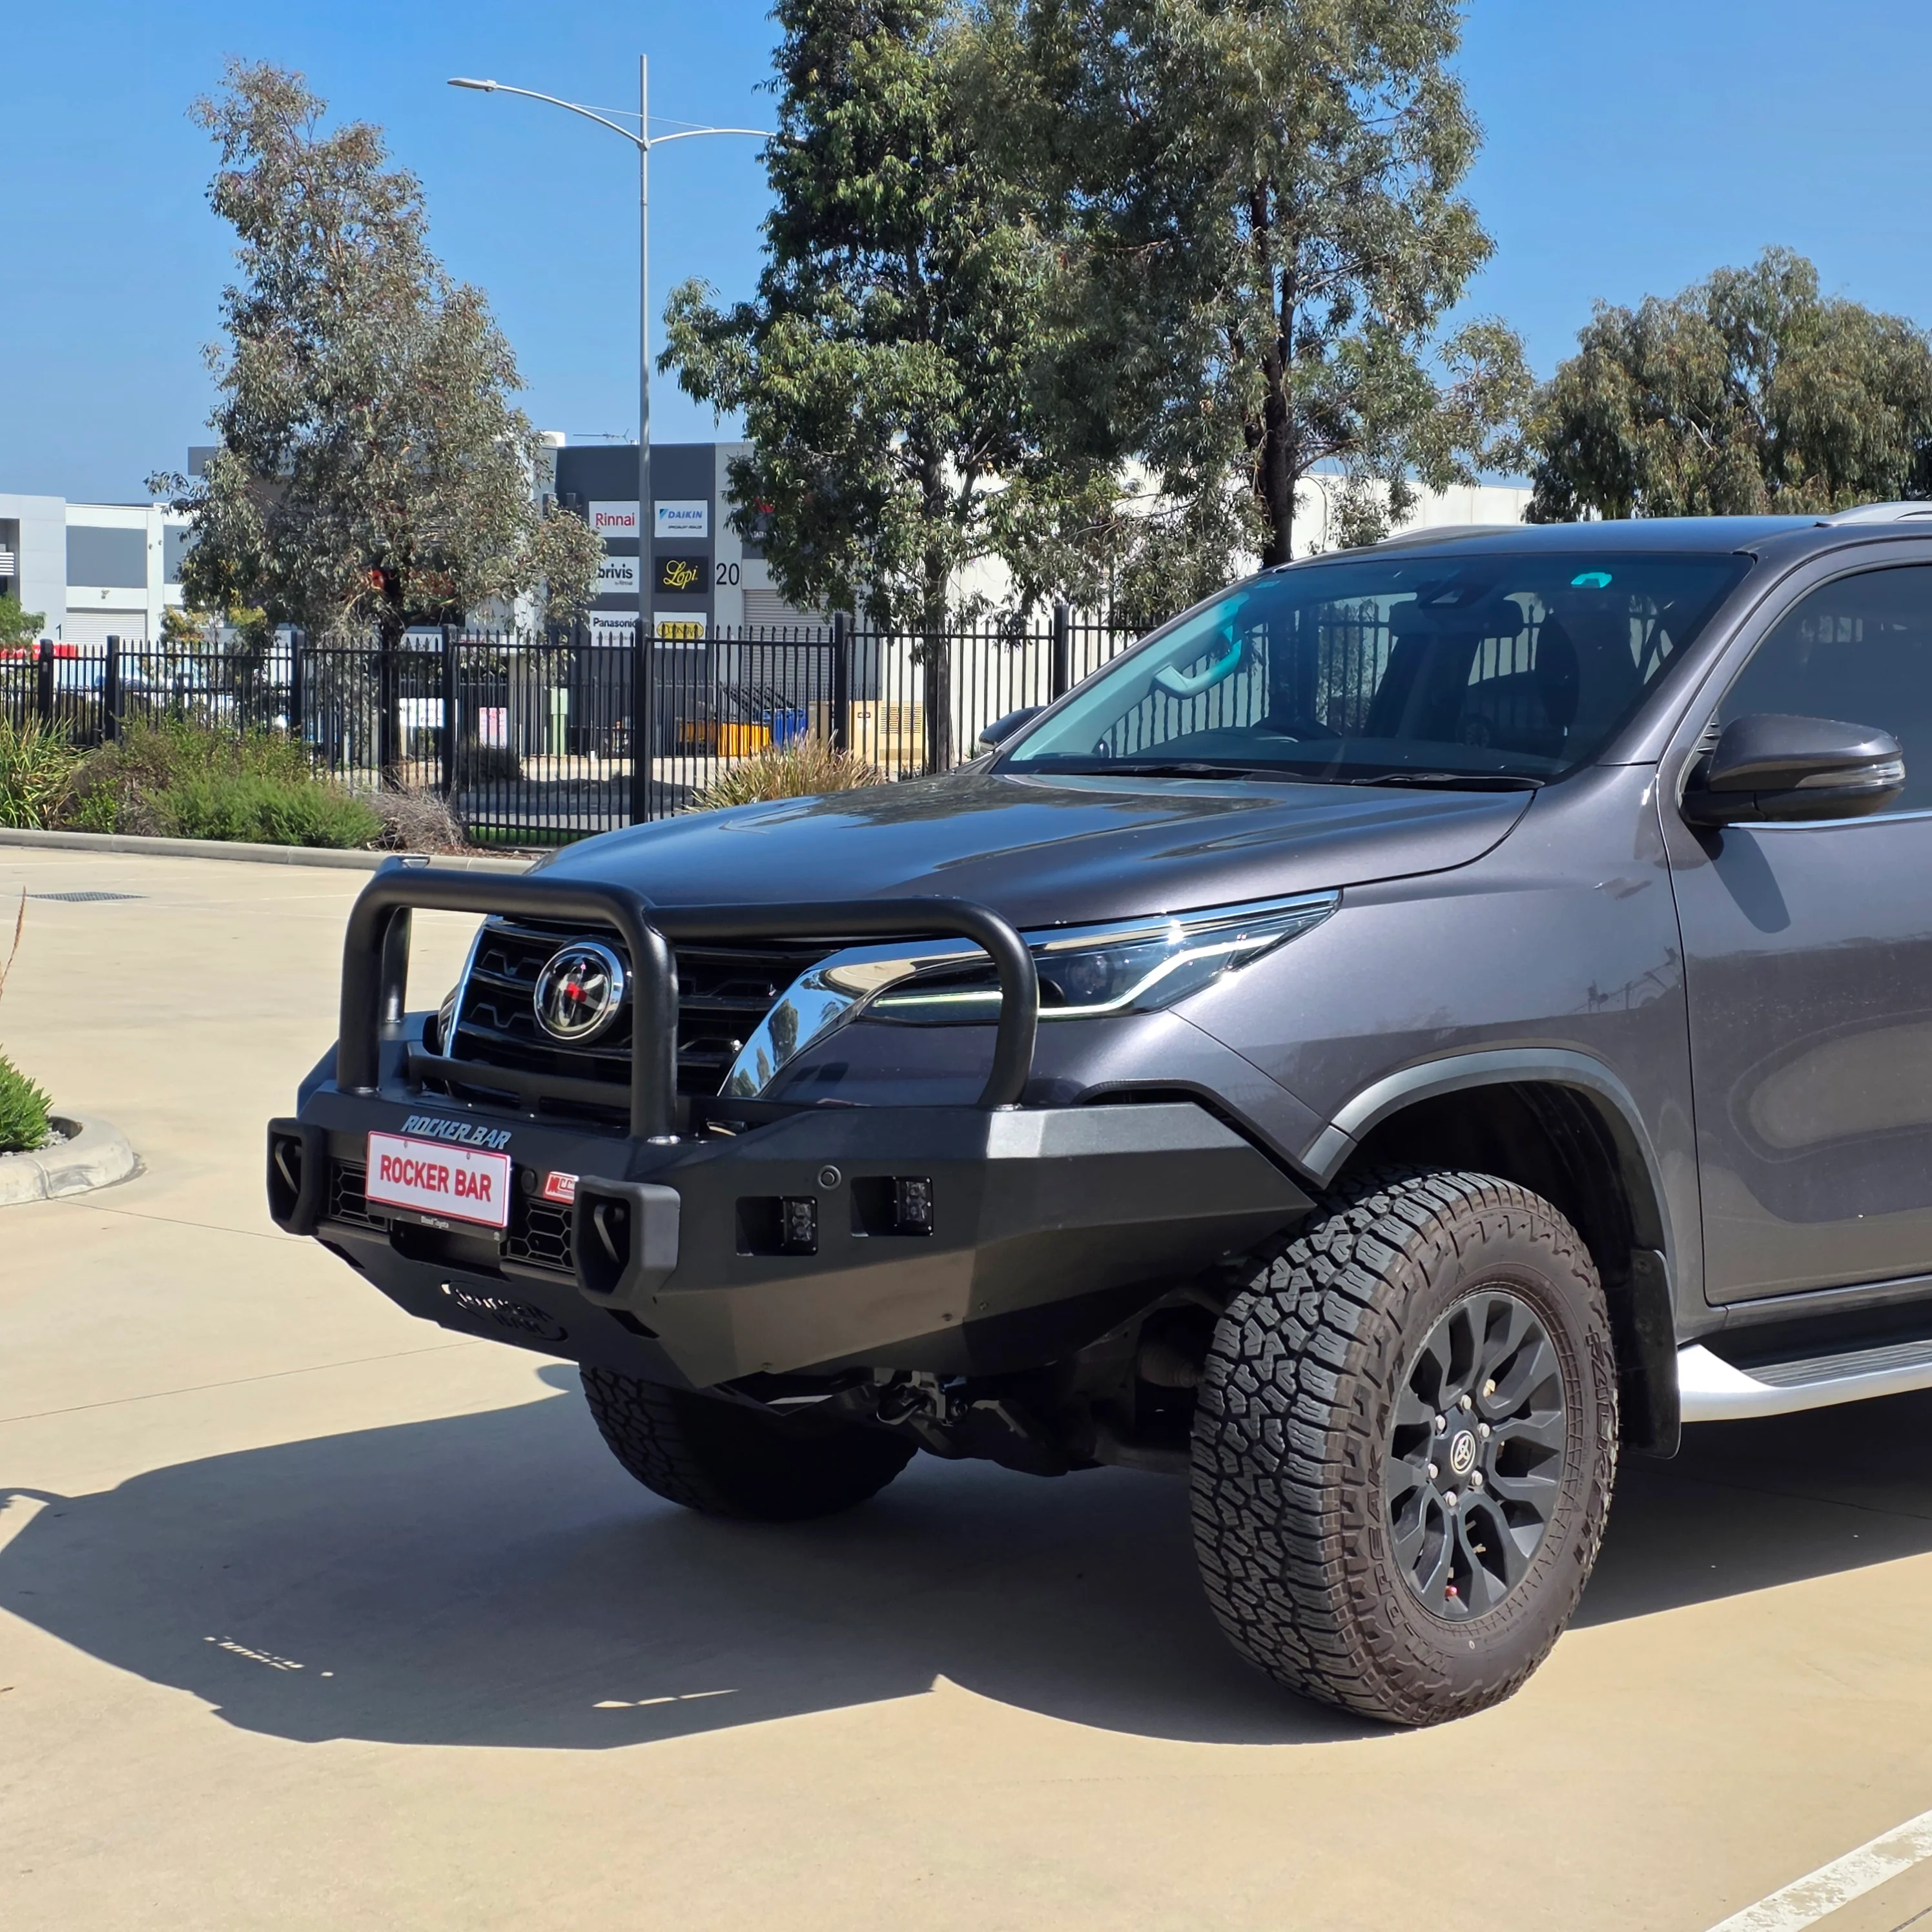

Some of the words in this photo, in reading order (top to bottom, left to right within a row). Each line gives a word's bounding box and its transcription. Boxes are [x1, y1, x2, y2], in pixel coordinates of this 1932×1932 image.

[595, 513, 635, 526] Rinnai
[598, 563, 633, 579] brivis
[663, 560, 698, 590] Lopi
[715, 562, 739, 585] 20
[56, 623, 61, 641] 1
[593, 617, 636, 628] Panasonic
[400, 1115, 472, 1143] ROCKER
[469, 1126, 512, 1149] BAR
[380, 1154, 449, 1193] ROCKER
[454, 1169, 491, 1202] BAR
